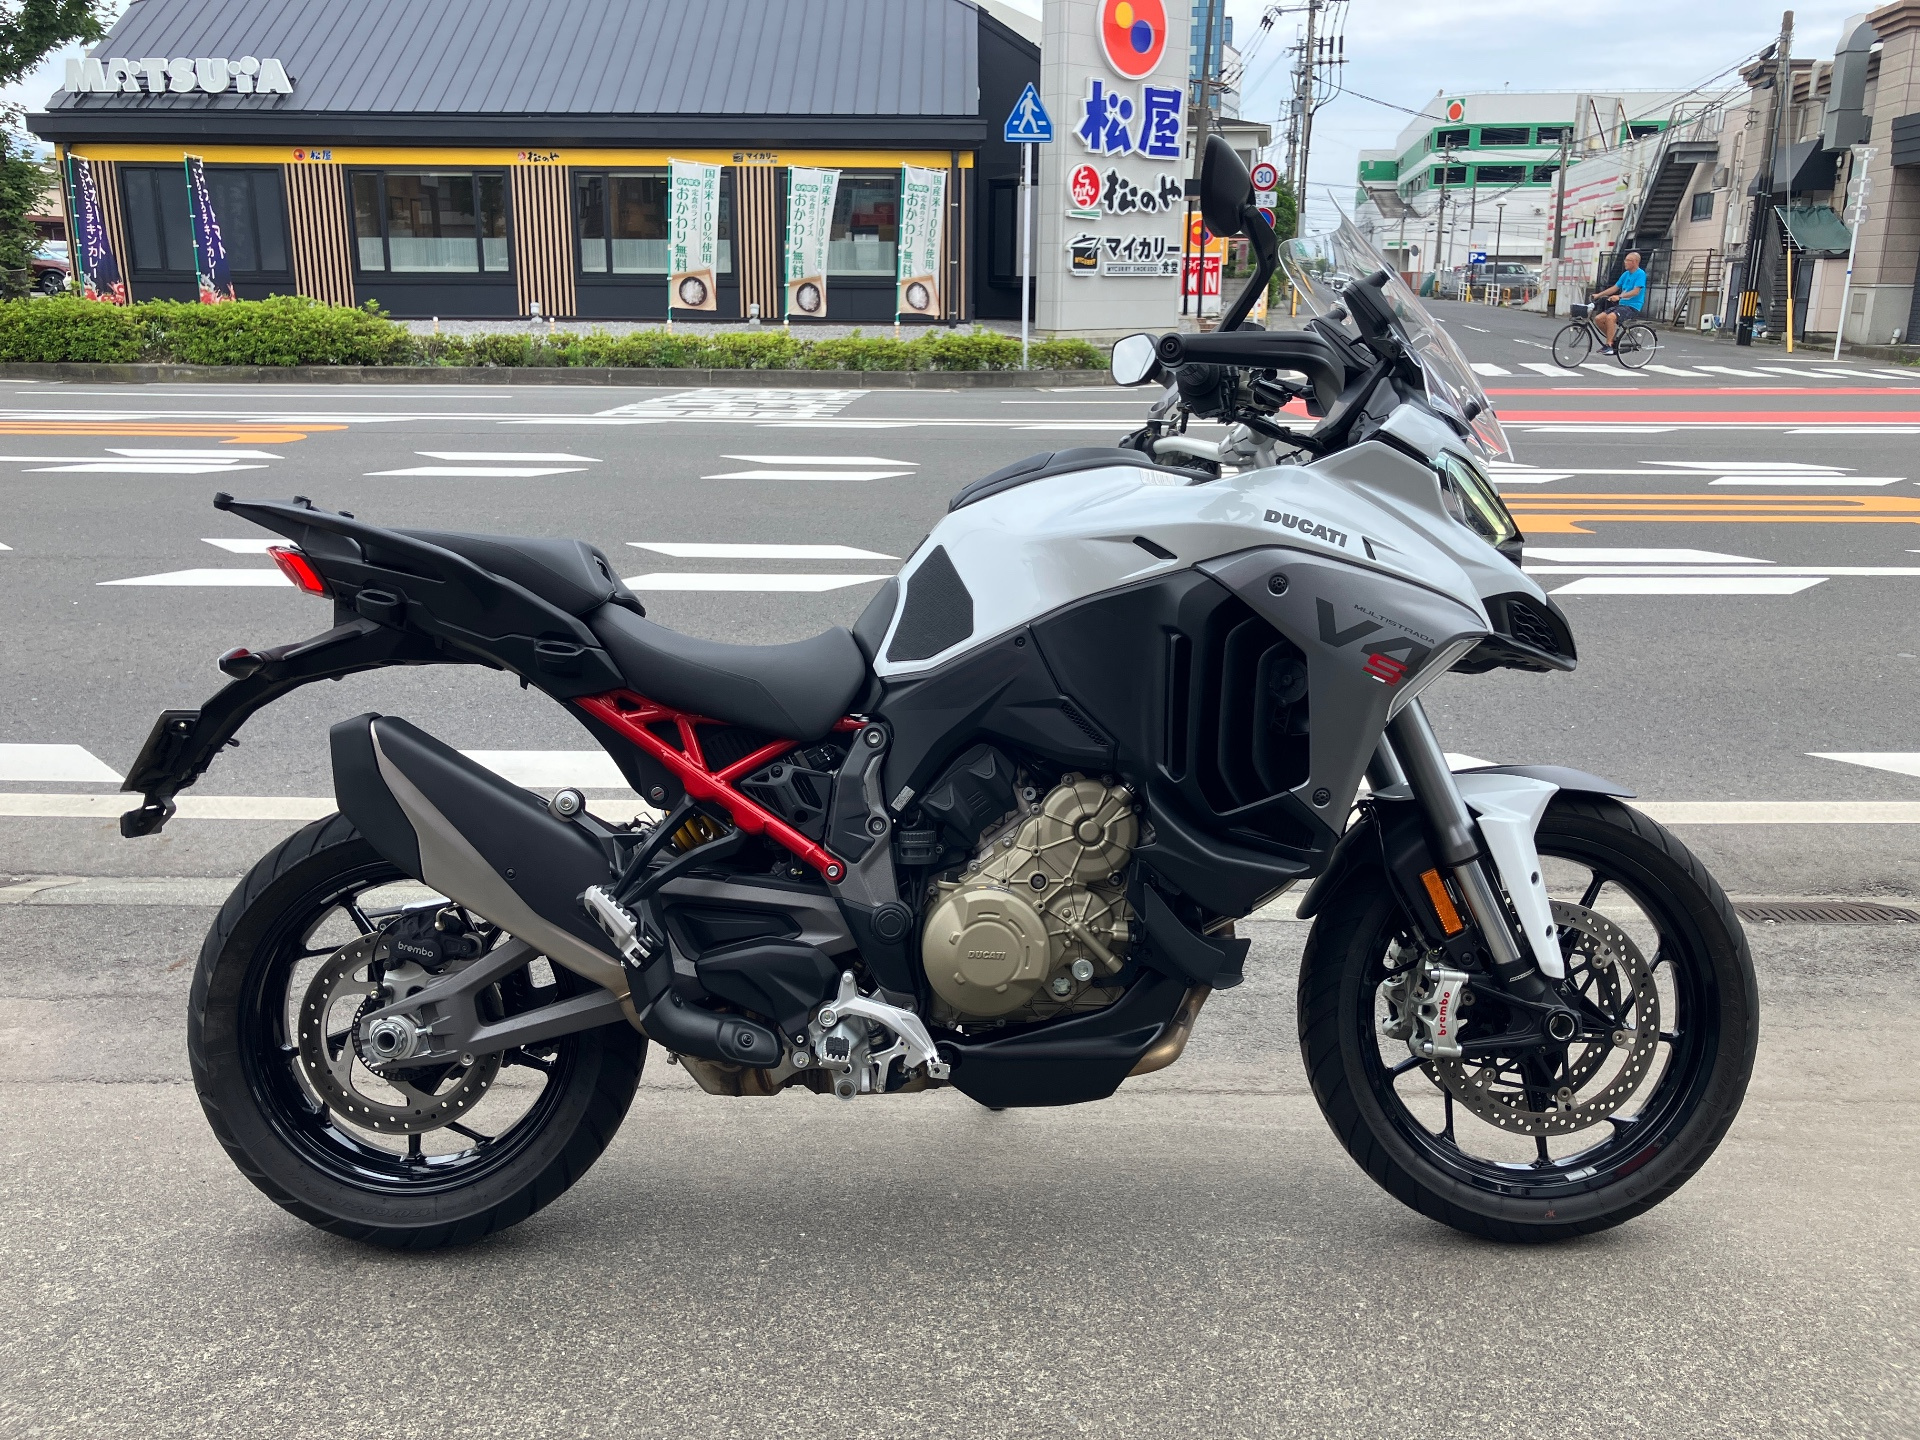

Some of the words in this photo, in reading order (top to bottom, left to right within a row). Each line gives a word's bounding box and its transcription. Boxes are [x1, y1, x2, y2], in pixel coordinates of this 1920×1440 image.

[1079, 79, 1182, 158] 松屋
[310, 151, 332, 160] 松屋
[1103, 170, 1182, 211] 松のや
[1256, 170, 1272, 184] 30
[675, 187, 689, 272] おかわり無料
[792, 194, 808, 279] おかわり無料
[902, 193, 919, 277] おかわり無料
[1106, 238, 1180, 260] マイカリー
[1161, 261, 1178, 274] 食堂
[1470, 253, 1478, 263] P
[1264, 509, 1348, 548] DUCATI
[1315, 596, 1432, 680] V4
[1354, 604, 1436, 645] MULTISTRADA
[1362, 653, 1408, 686] S
[397, 940, 434, 957] brembo
[967, 950, 1006, 960] DUCATI
[1438, 991, 1451, 1036] brembo
